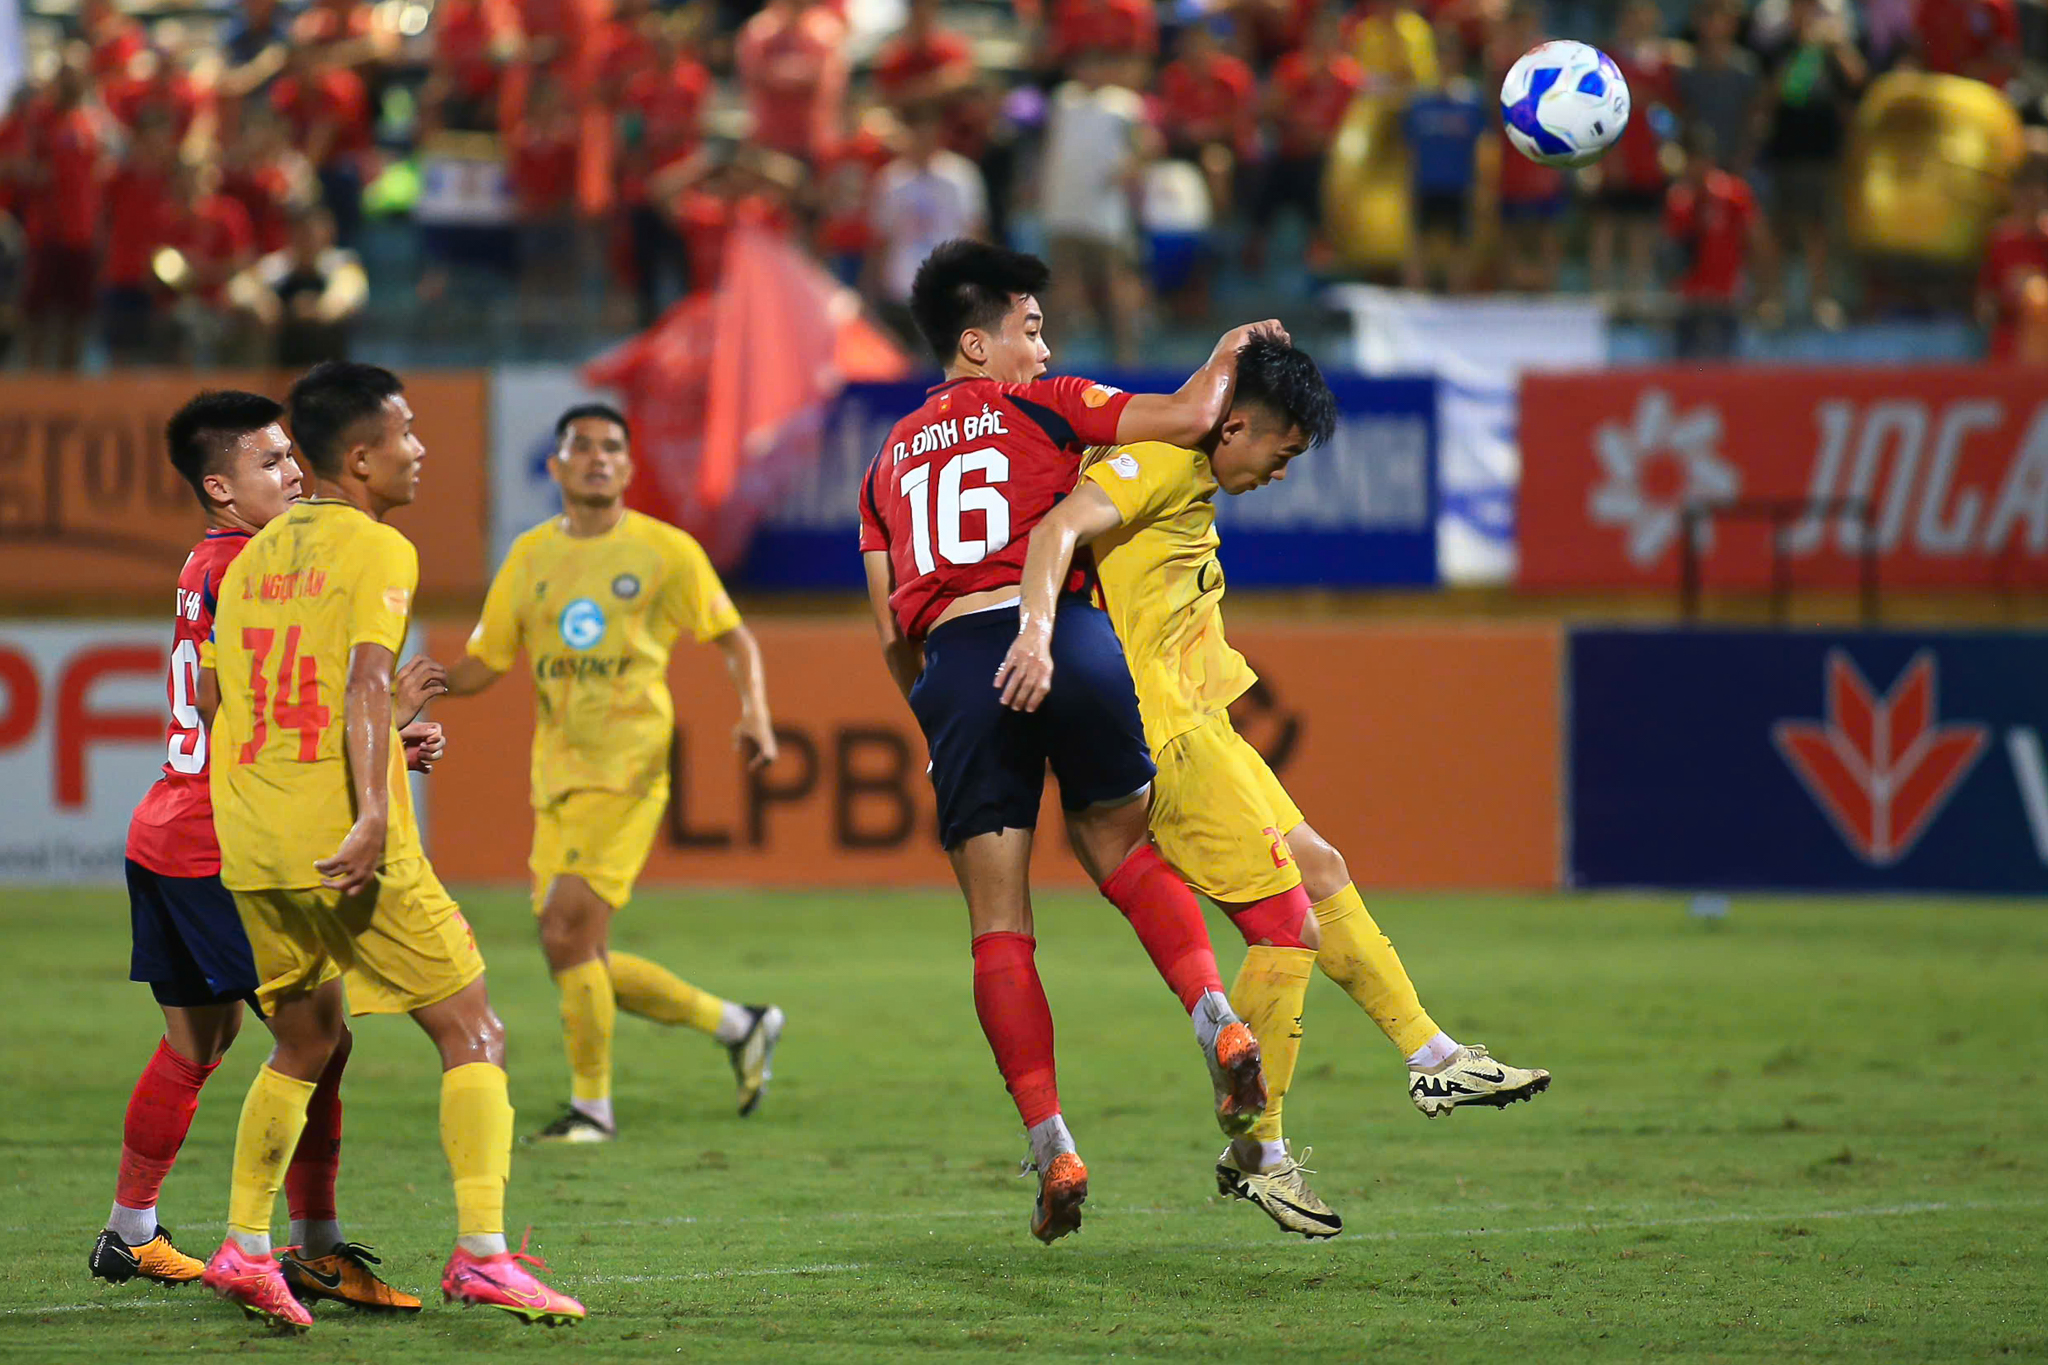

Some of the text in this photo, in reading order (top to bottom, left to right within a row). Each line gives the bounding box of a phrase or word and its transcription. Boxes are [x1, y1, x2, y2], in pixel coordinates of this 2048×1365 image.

[963, 402, 1010, 442] BẮC
[900, 446, 1011, 578] 16
[238, 624, 331, 766] 34
[664, 720, 918, 852] LPB
